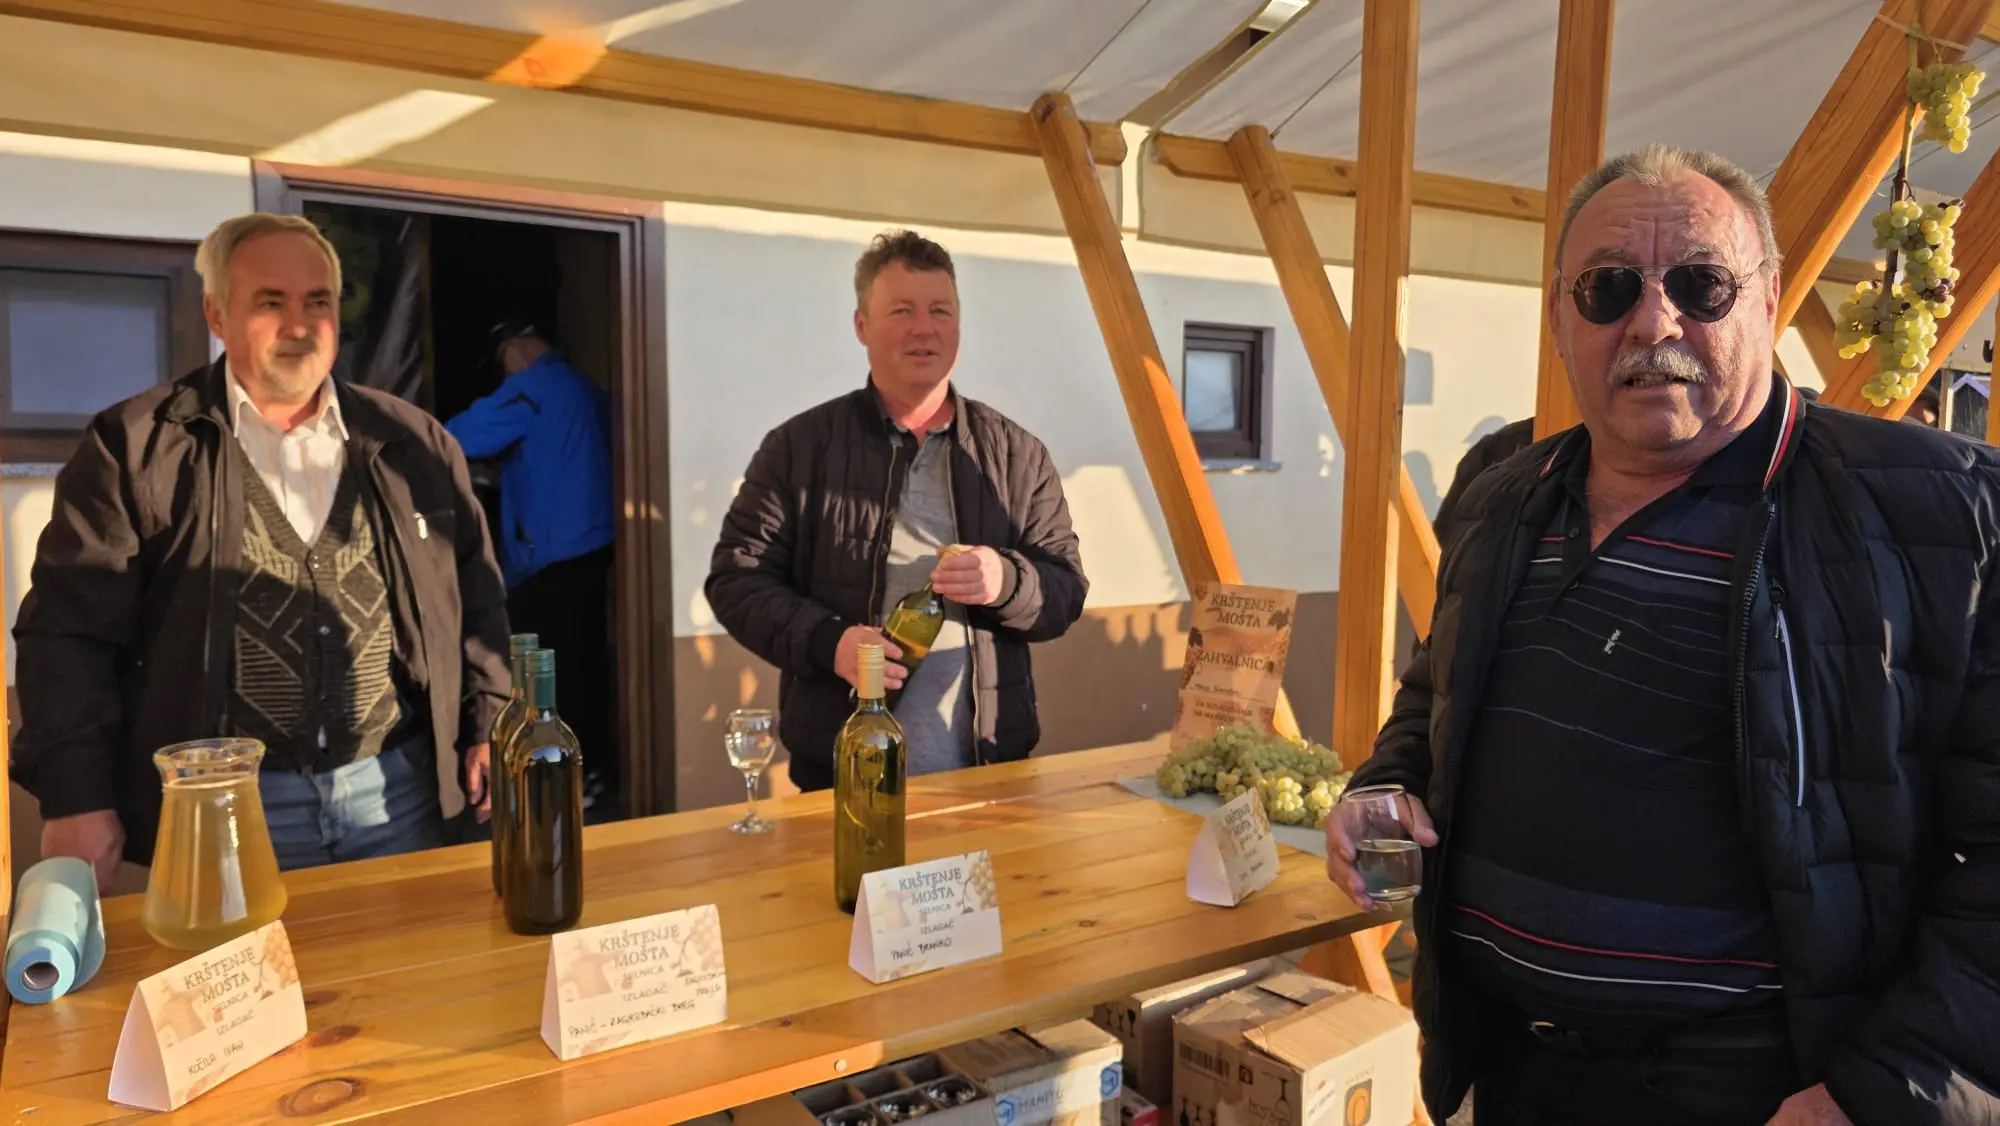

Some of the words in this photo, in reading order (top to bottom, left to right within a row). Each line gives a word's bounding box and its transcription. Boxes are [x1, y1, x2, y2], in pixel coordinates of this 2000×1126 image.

[1210, 592, 1276, 612] KRŠTENJE
[1217, 611, 1261, 628] MOŠTA
[1196, 650, 1274, 673] ZAHVALNICA
[899, 867, 962, 891] KRŠTENJE
[911, 885, 955, 905] MOŠTA
[599, 924, 680, 952] KRŠTENJE
[613, 945, 669, 968] MOŠTA
[183, 947, 256, 990] KRŠTENJE
[201, 970, 251, 1004] MOŠTA
